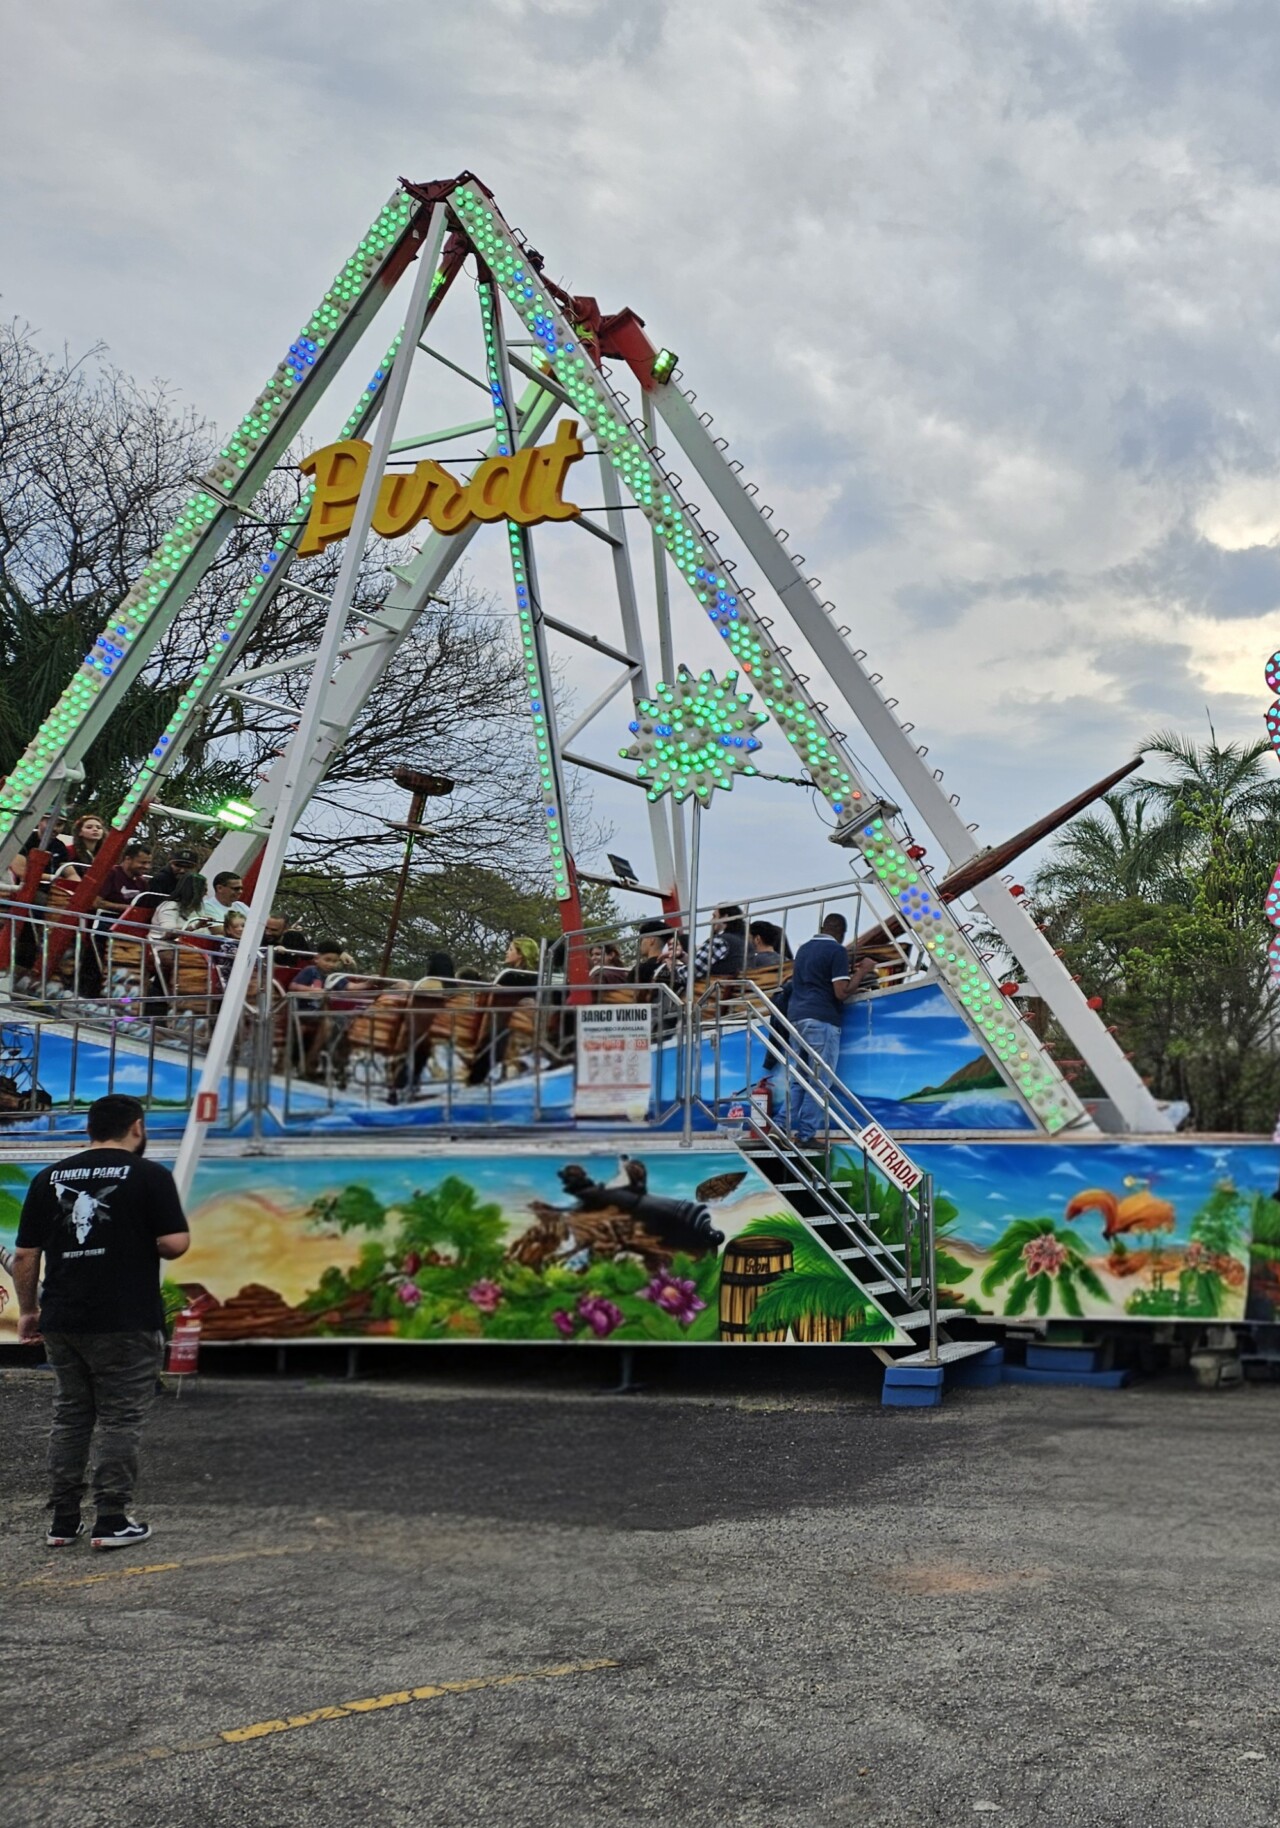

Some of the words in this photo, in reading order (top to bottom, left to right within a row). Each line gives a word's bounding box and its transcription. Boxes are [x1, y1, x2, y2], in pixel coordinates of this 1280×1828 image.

[581, 1009, 613, 1023] BARCO
[615, 1008, 648, 1022] VIKING
[862, 1126, 919, 1189] ENTRADA
[52, 1168, 91, 1181] LINKIN
[92, 1166, 122, 1179] PARK
